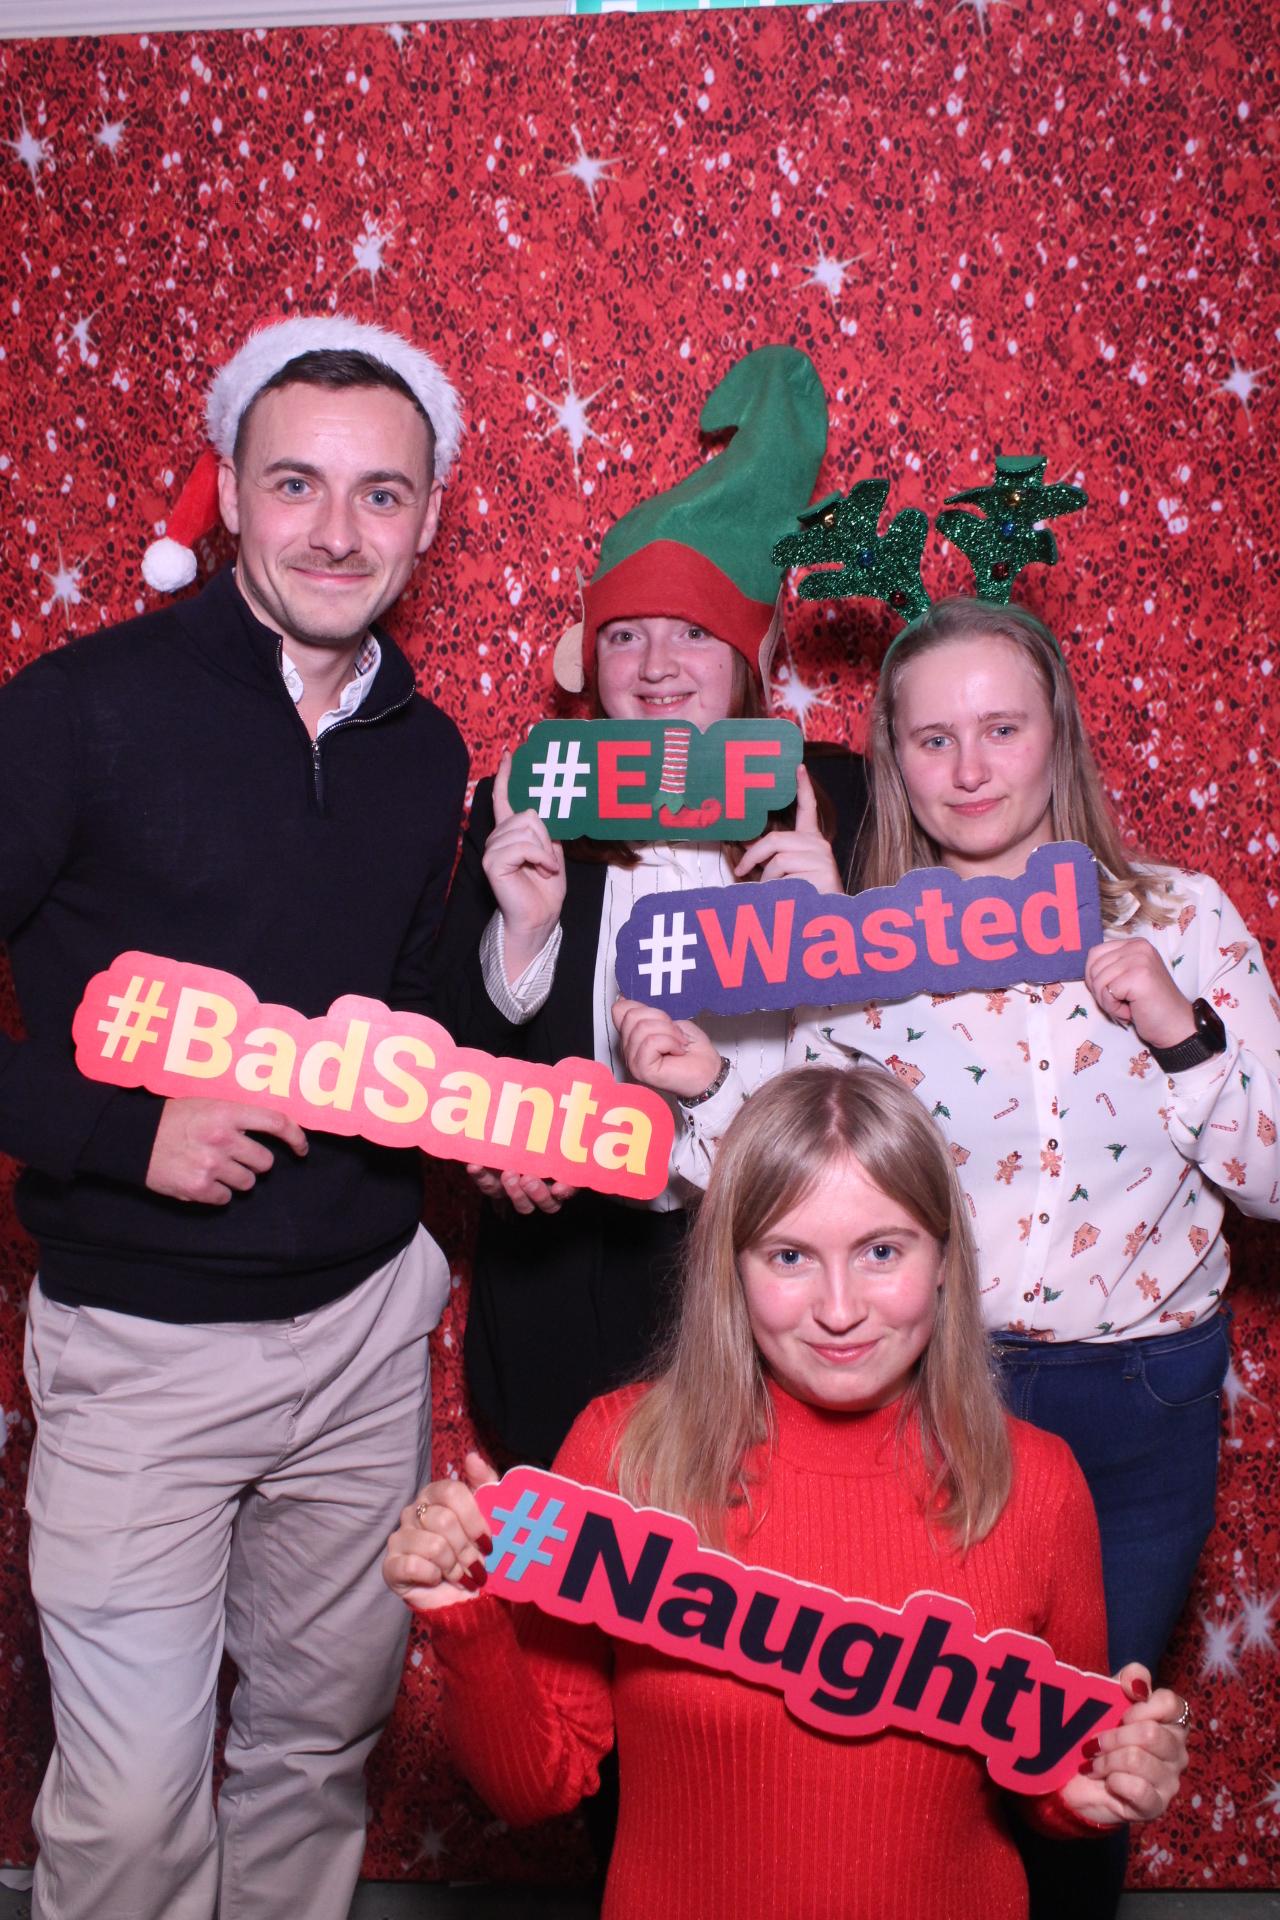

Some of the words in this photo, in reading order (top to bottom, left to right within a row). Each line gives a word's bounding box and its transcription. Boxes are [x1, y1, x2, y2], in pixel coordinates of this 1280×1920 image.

[637, 862, 1083, 996] #Wasted
[96, 975, 653, 1176] #BadSanta
[484, 1489, 1114, 1776] #Naughty
